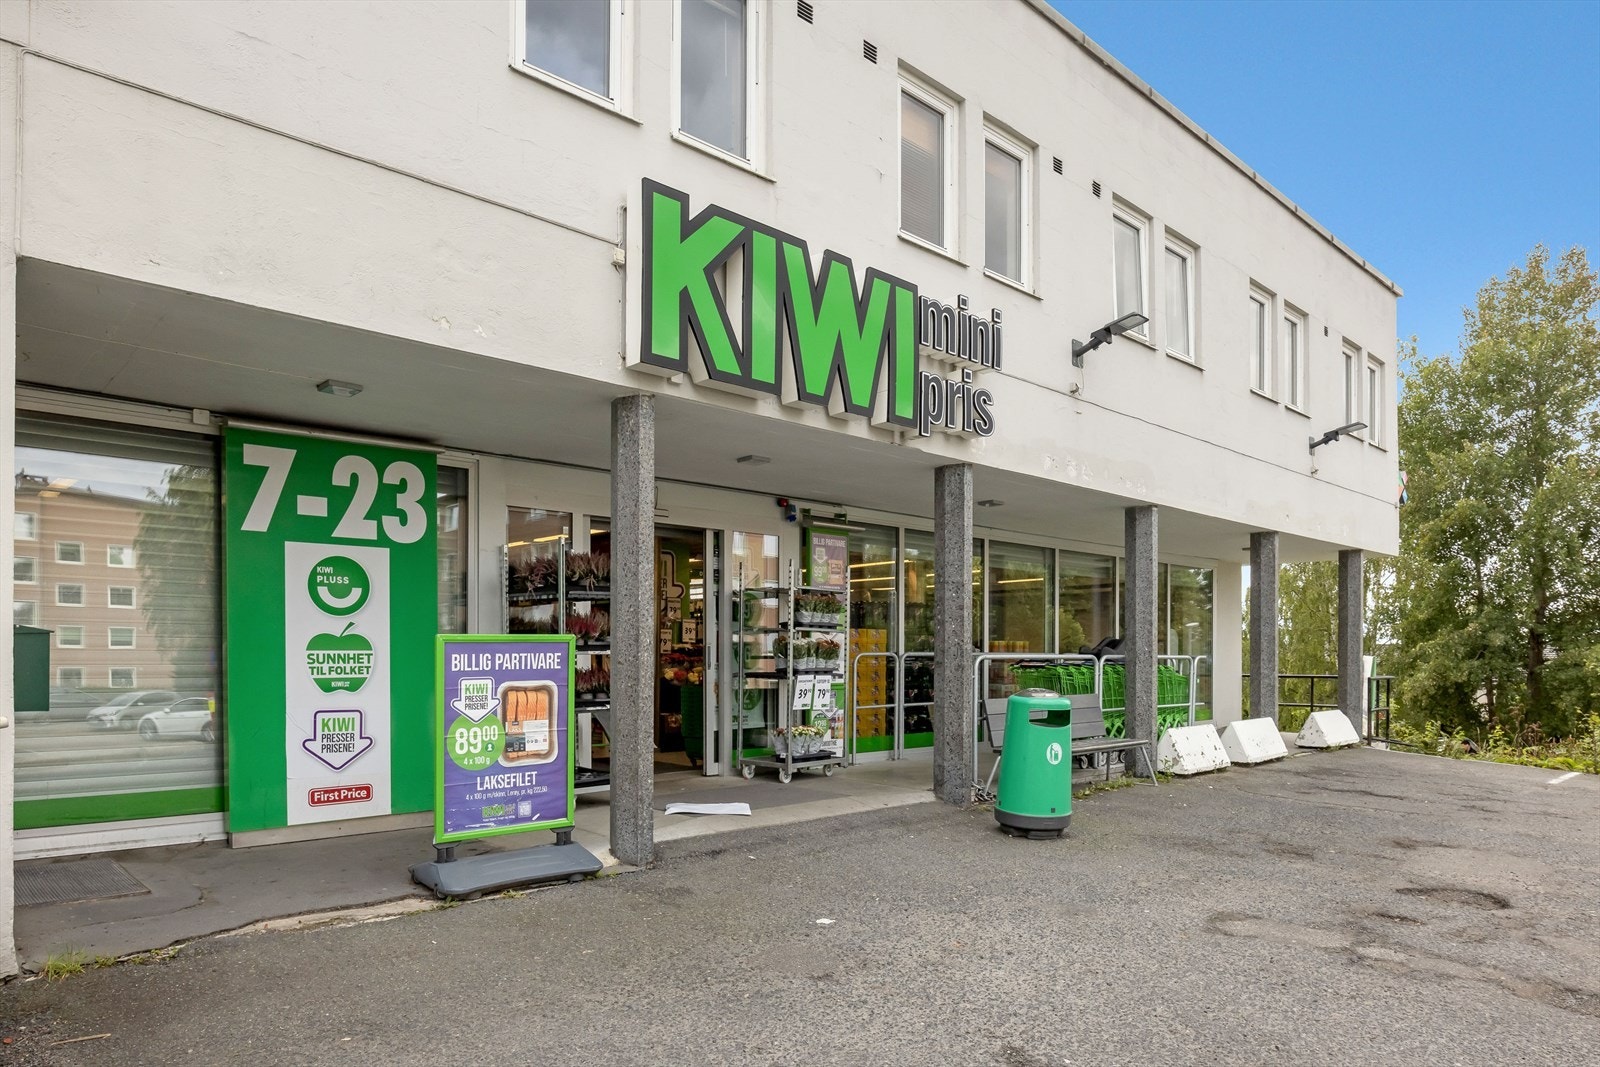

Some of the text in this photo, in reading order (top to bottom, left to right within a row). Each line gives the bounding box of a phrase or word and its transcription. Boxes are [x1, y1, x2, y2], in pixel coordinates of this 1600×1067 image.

[641, 177, 918, 429] KIWI
[919, 294, 1002, 371] mini
[919, 369, 995, 437] pris
[316, 566, 334, 574] KIWI
[316, 575, 349, 584] PLUSS
[306, 653, 373, 665] SUNNHET
[451, 652, 562, 672] BILLIG PARTIVARE
[308, 665, 371, 676] TIL FOLKET
[464, 683, 488, 695] KIWI
[464, 695, 488, 703] PRESSER
[464, 702, 488, 711] PRISENE!
[321, 717, 355, 733] KIWI
[321, 732, 355, 743] PRESSER
[320, 742, 355, 754] PRISENE!
[476, 771, 538, 791] LAKSEFILET
[314, 787, 367, 802] First Price
